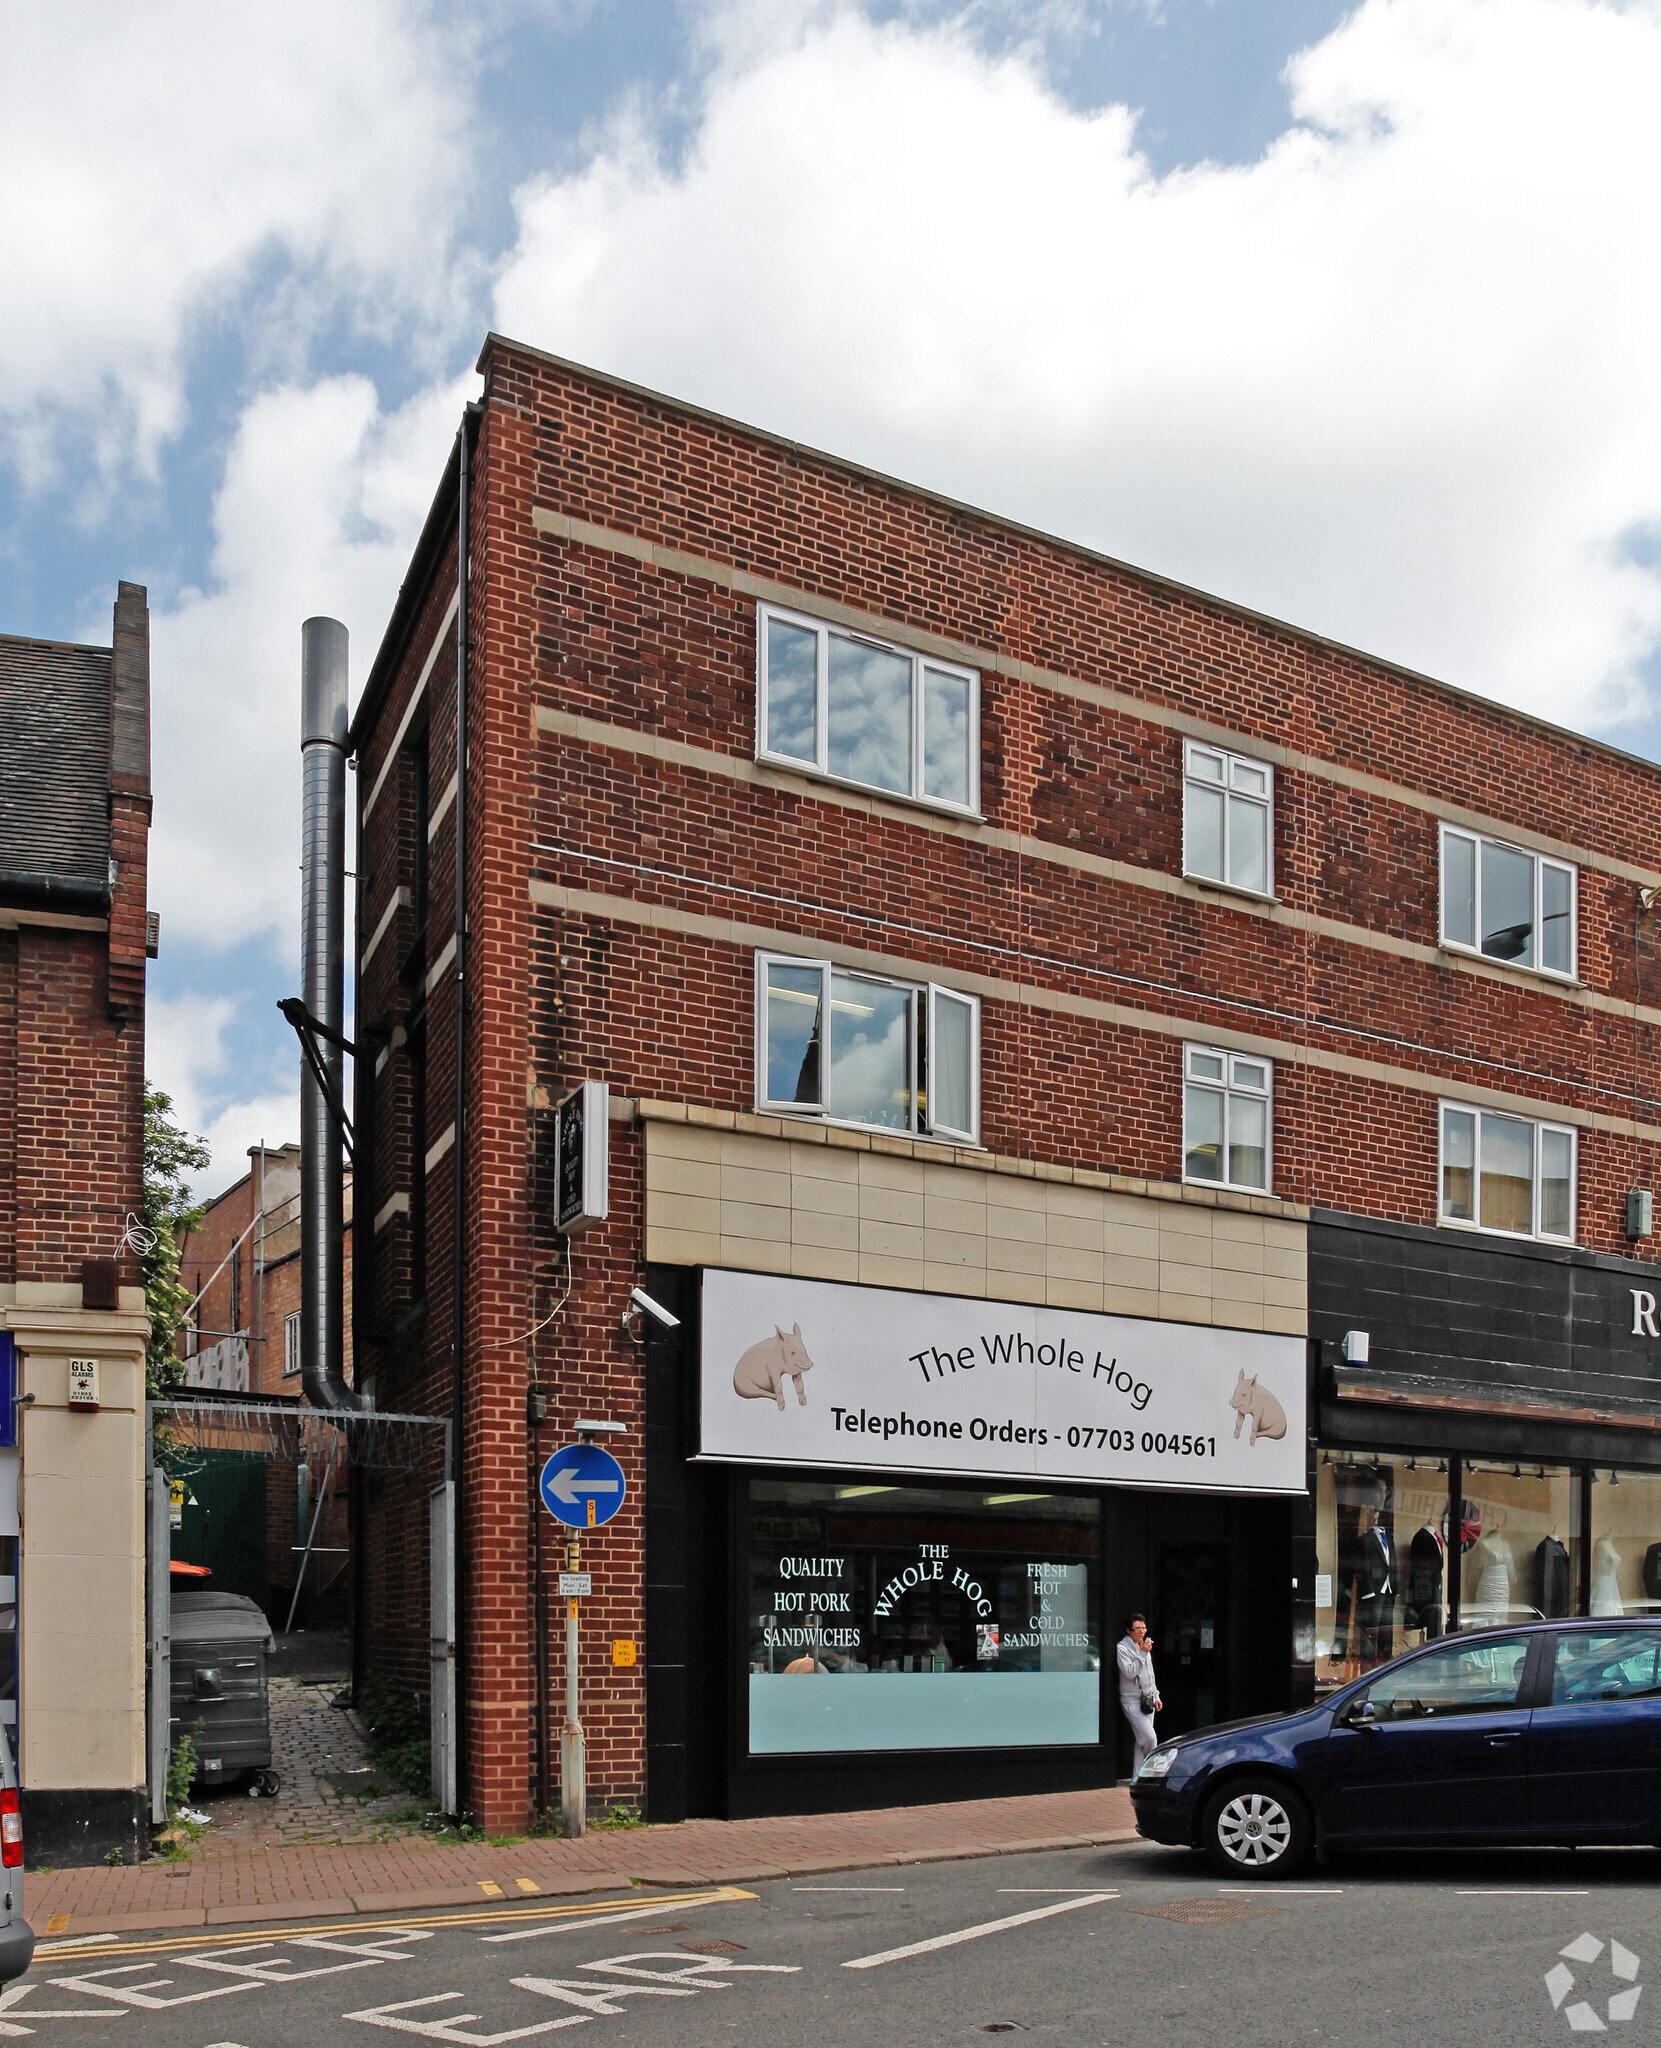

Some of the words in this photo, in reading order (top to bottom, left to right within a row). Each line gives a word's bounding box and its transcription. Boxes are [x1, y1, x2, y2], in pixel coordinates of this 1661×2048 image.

[1630, 1288, 1661, 1338] R
[72, 1361, 93, 1372] GLS
[909, 1346, 976, 1383] The
[980, 1333, 1085, 1373] Whole
[1092, 1351, 1154, 1411] Hog
[831, 1407, 963, 1441] Telephone
[969, 1417, 1048, 1446] Orders
[1067, 1426, 1135, 1452] 07703
[1141, 1432, 1217, 1458] 004561
[588, 1502, 594, 1511] S
[589, 1514, 593, 1522] 1
[919, 1544, 949, 1558] THE
[779, 1557, 844, 1579] QUALITY
[1027, 1563, 1068, 1578] FRESH
[873, 1561, 944, 1617] WHOLE
[951, 1567, 993, 1618] HOG
[1033, 1581, 1061, 1595] HOT
[774, 1592, 805, 1611] HOT
[810, 1593, 850, 1612] PORK
[1041, 1599, 1052, 1612] &
[1029, 1616, 1065, 1630] COLD
[763, 1627, 860, 1647] SANDWICHES
[1003, 1633, 1089, 1648] SANDWICHES
